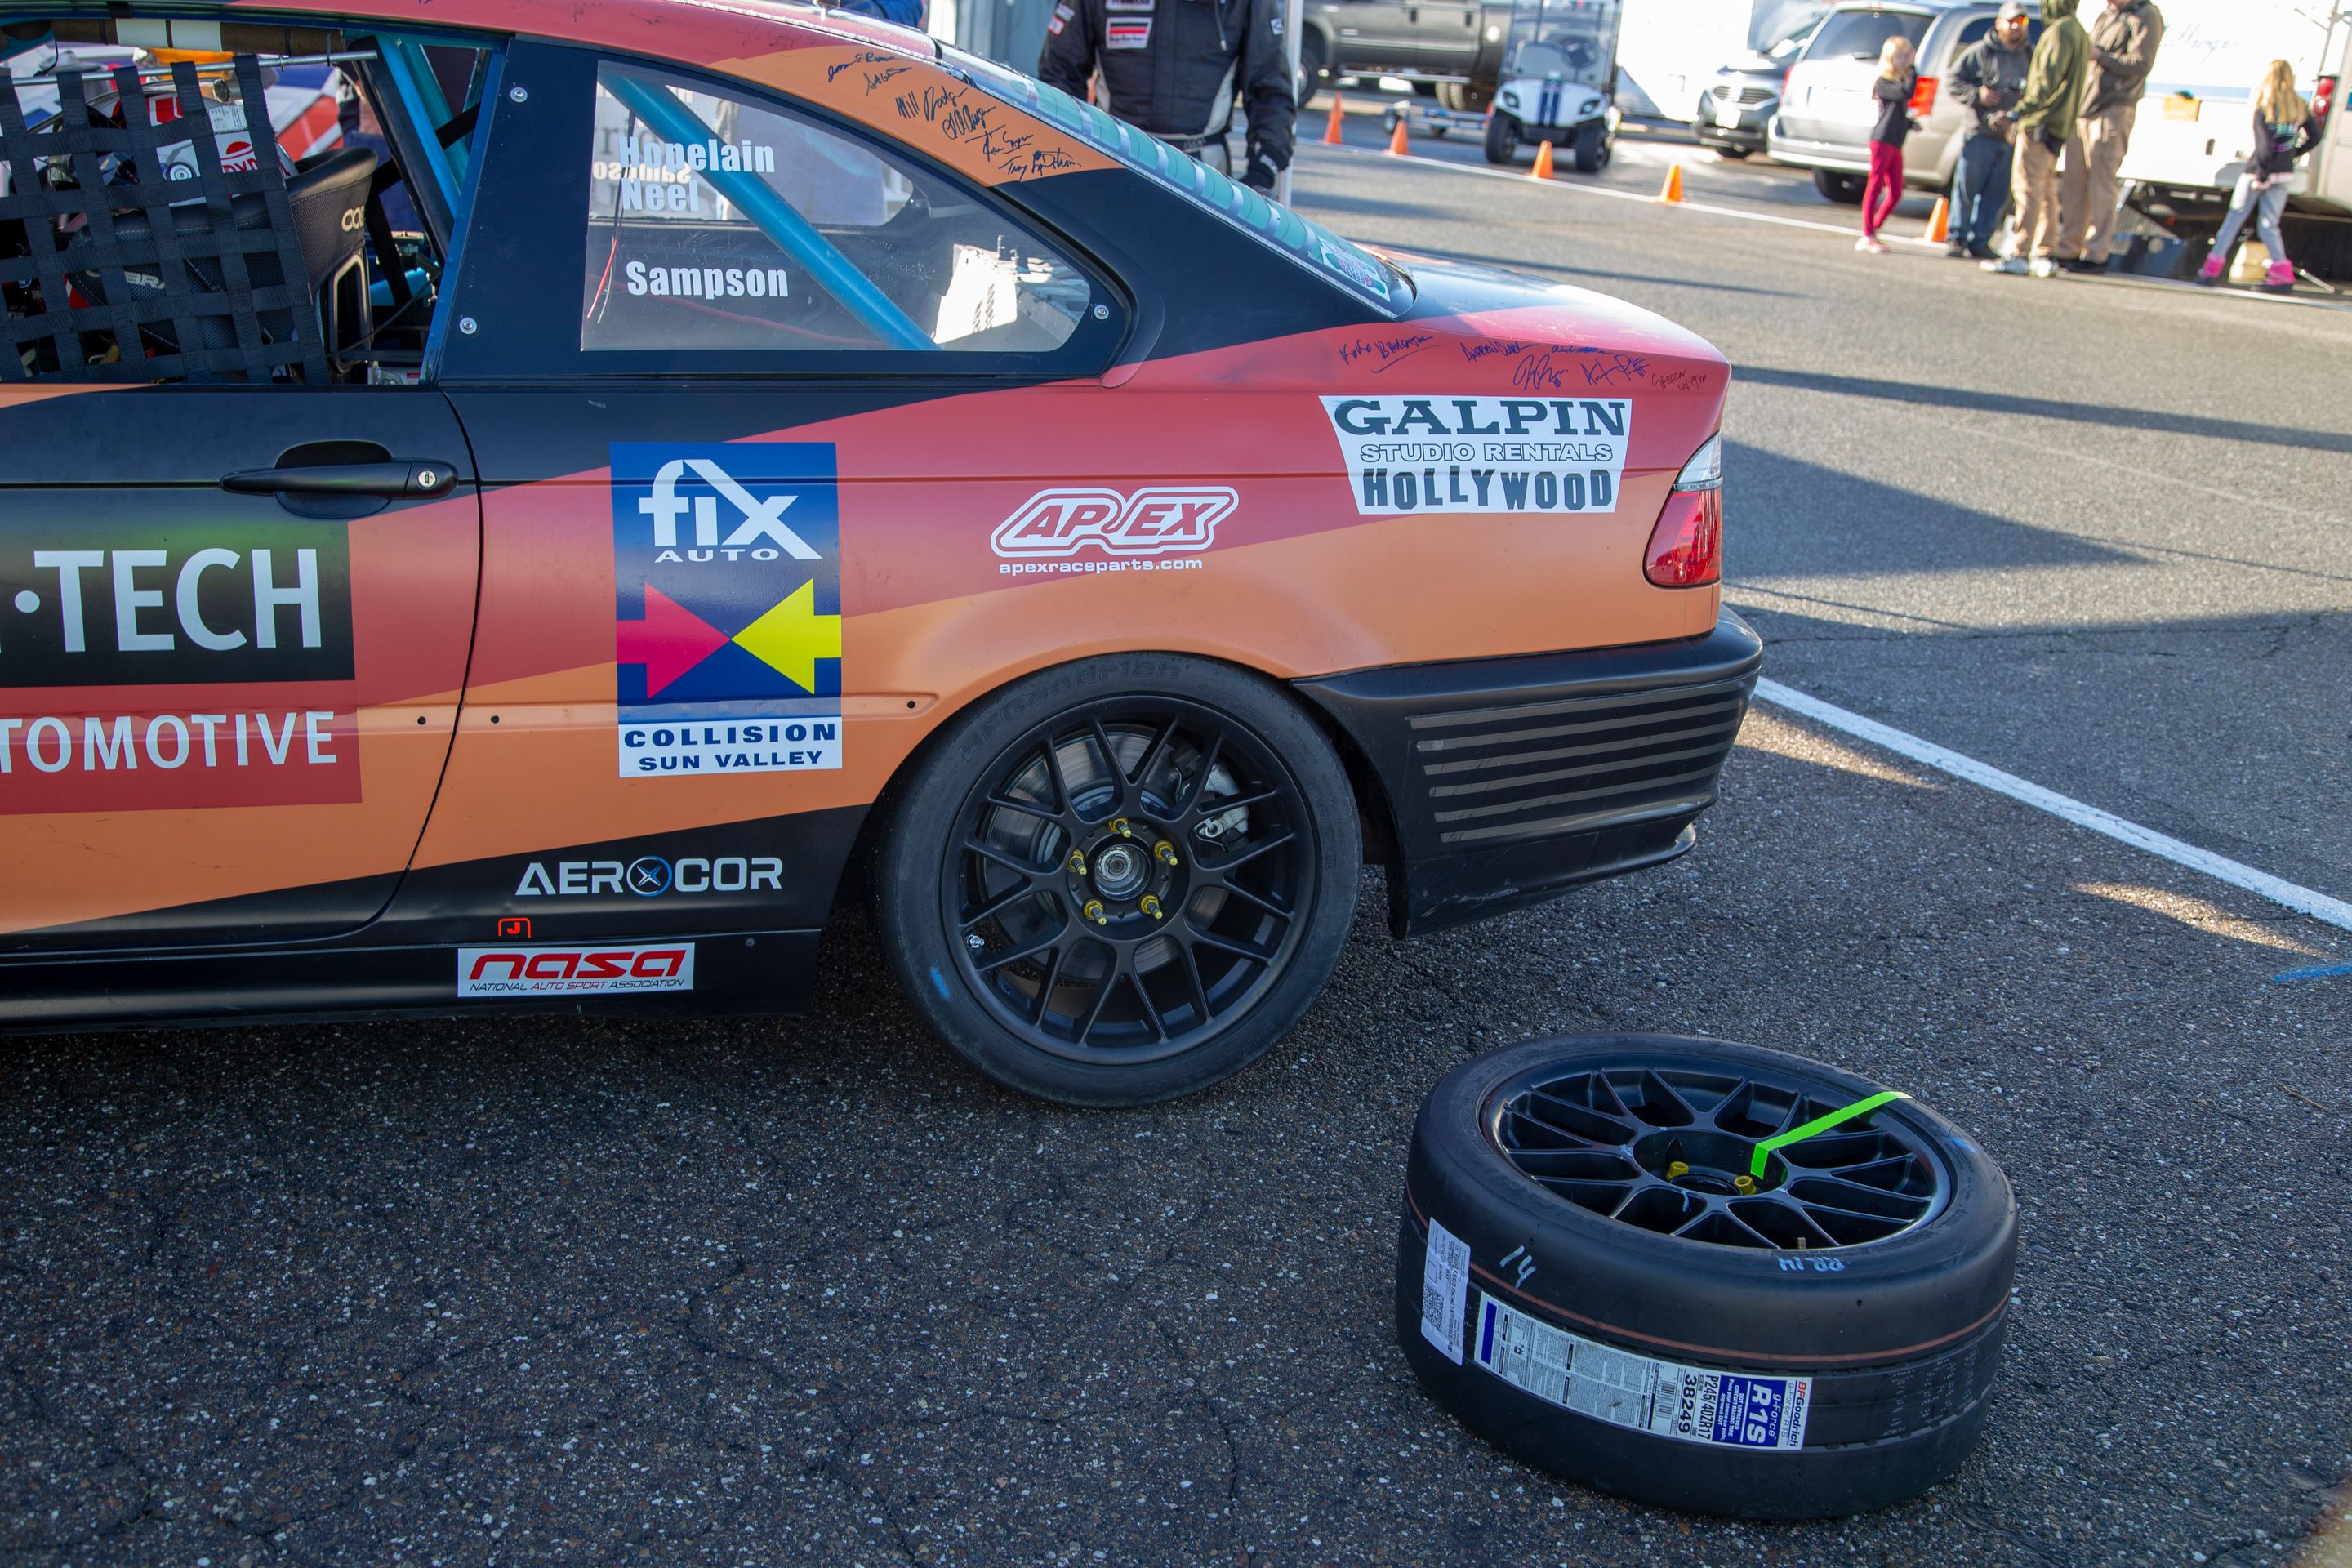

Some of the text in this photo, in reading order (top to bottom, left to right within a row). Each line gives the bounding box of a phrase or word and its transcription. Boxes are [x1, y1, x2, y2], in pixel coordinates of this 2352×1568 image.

[618, 136, 775, 173] Hopelain
[621, 177, 699, 212] Neel
[626, 261, 789, 300] Sampson
[1334, 399, 1626, 437] GALPIN
[1360, 443, 1614, 462] STUDIO RENTALS
[1362, 465, 1613, 511] HOLLYWOOD
[999, 495, 1232, 548] APEX
[654, 548, 779, 564] AUTO
[999, 558, 1203, 577] apexraceparts.com
[624, 723, 835, 748] COLLISION
[639, 750, 823, 771] SUN VALLEY
[469, 949, 687, 980] nasa
[469, 978, 686, 992] NATIONAL AUTO SPORT ASSOCIATION
[1677, 1374, 1699, 1434] 38249
[1697, 1374, 1720, 1441] P245/40ZR17
[1744, 1383, 1773, 1444] R1S
[1788, 1380, 1807, 1447] BFGoodrich
